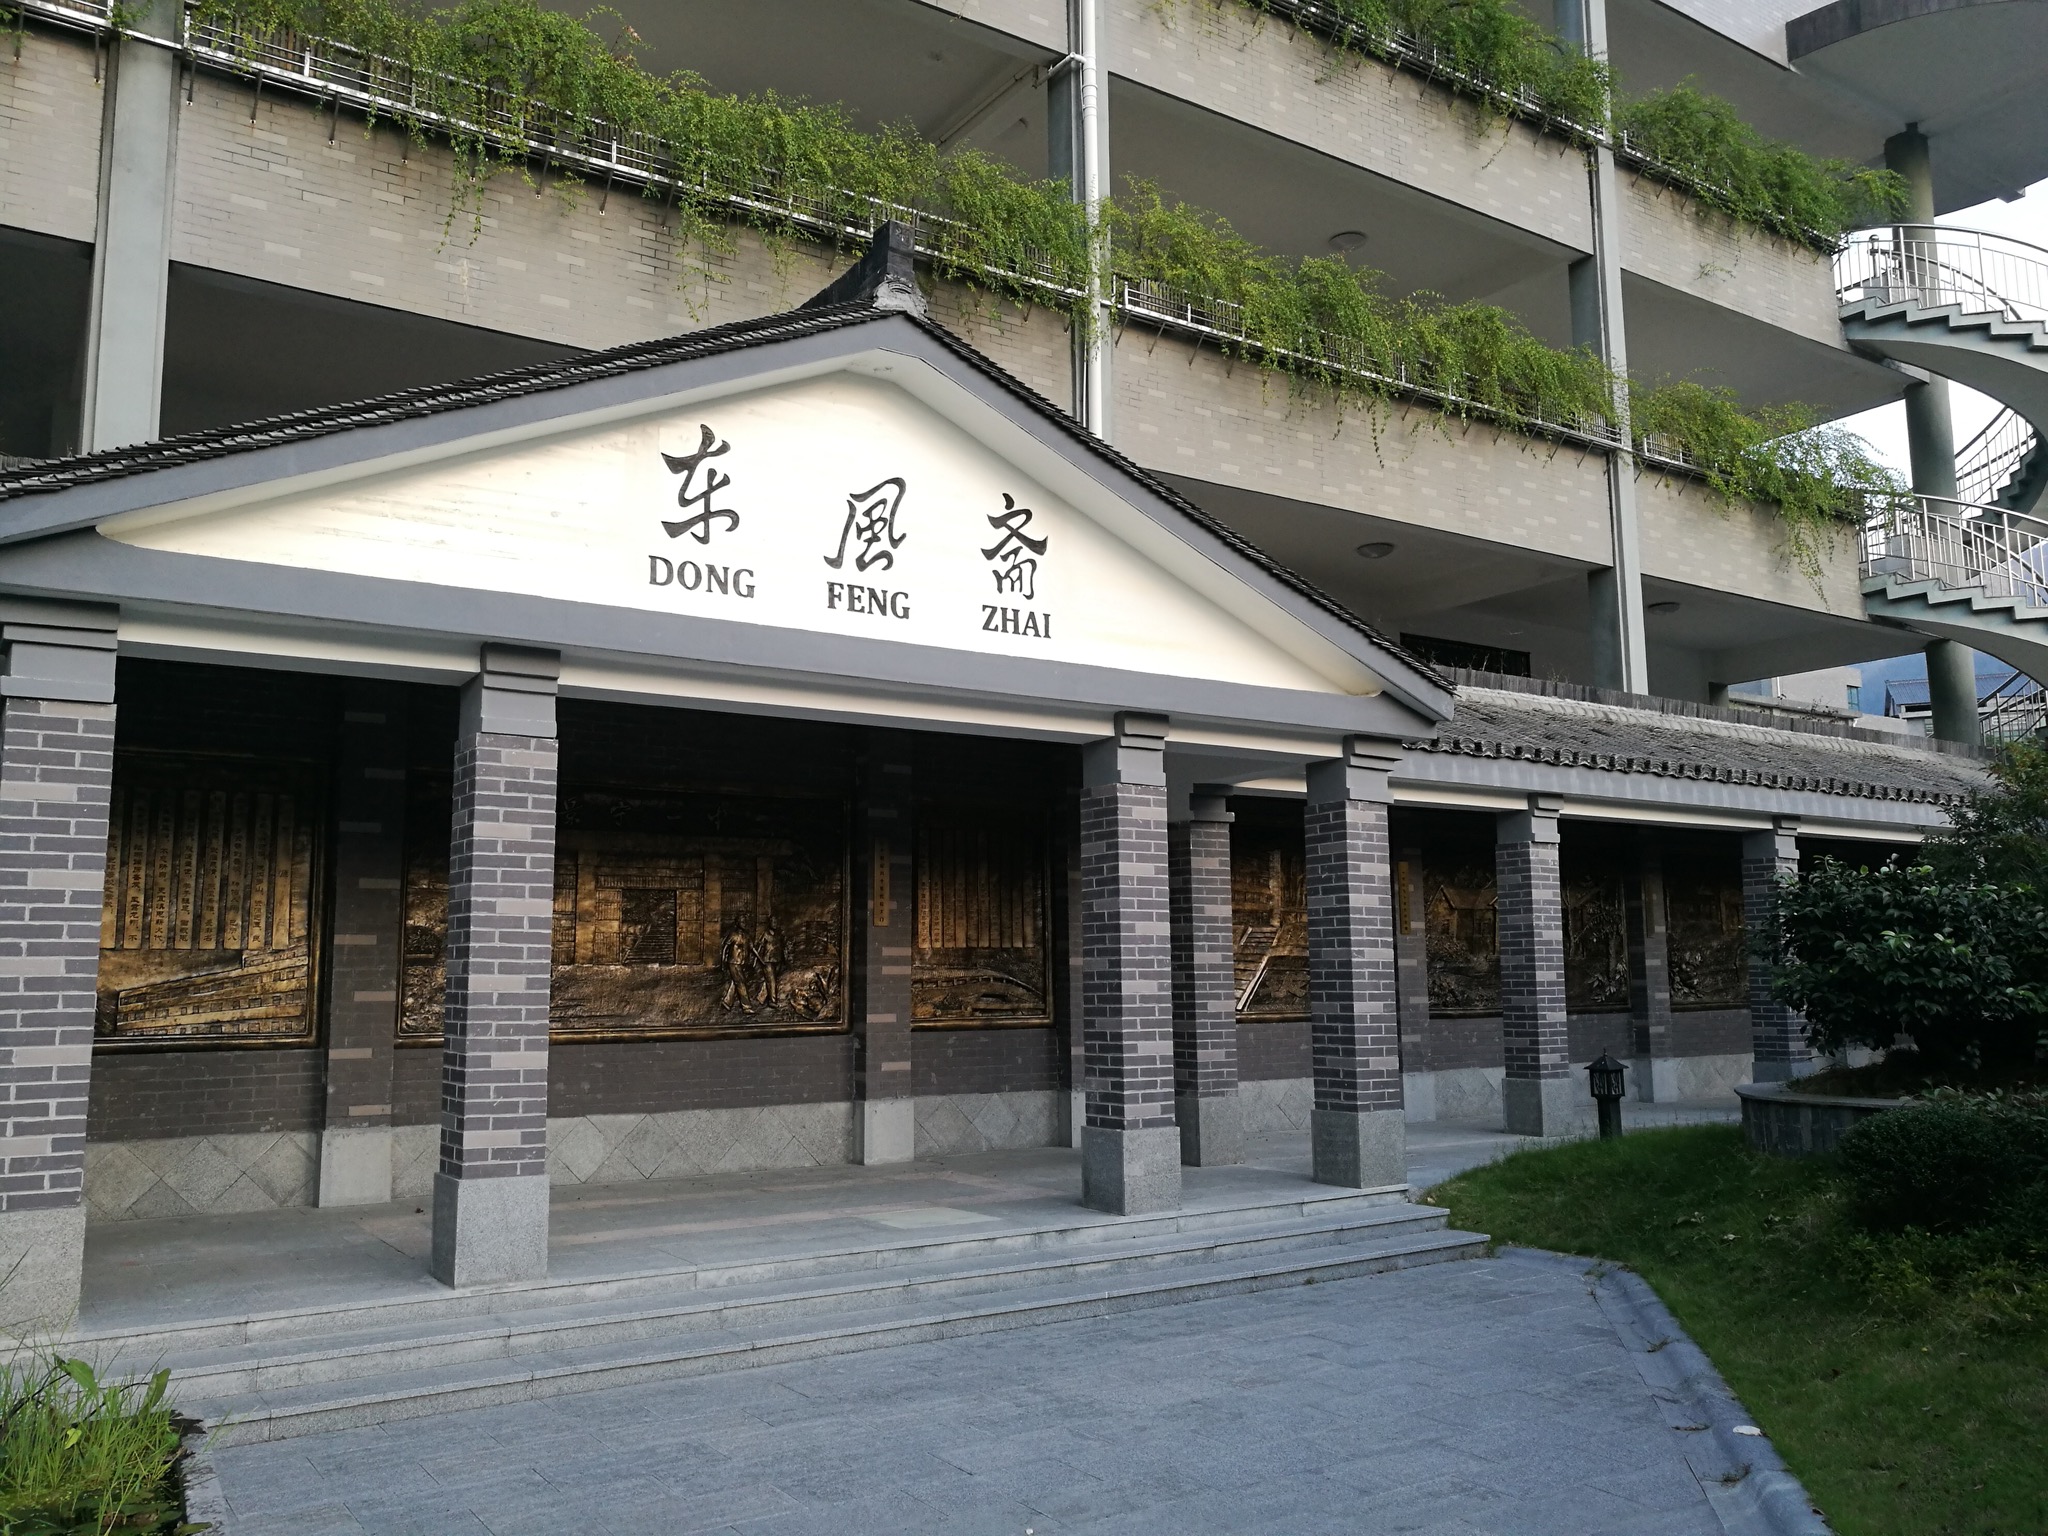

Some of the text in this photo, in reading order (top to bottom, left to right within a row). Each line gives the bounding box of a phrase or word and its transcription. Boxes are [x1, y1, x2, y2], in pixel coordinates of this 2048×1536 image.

[648, 555, 1051, 639] DONG FENG ZHAI
